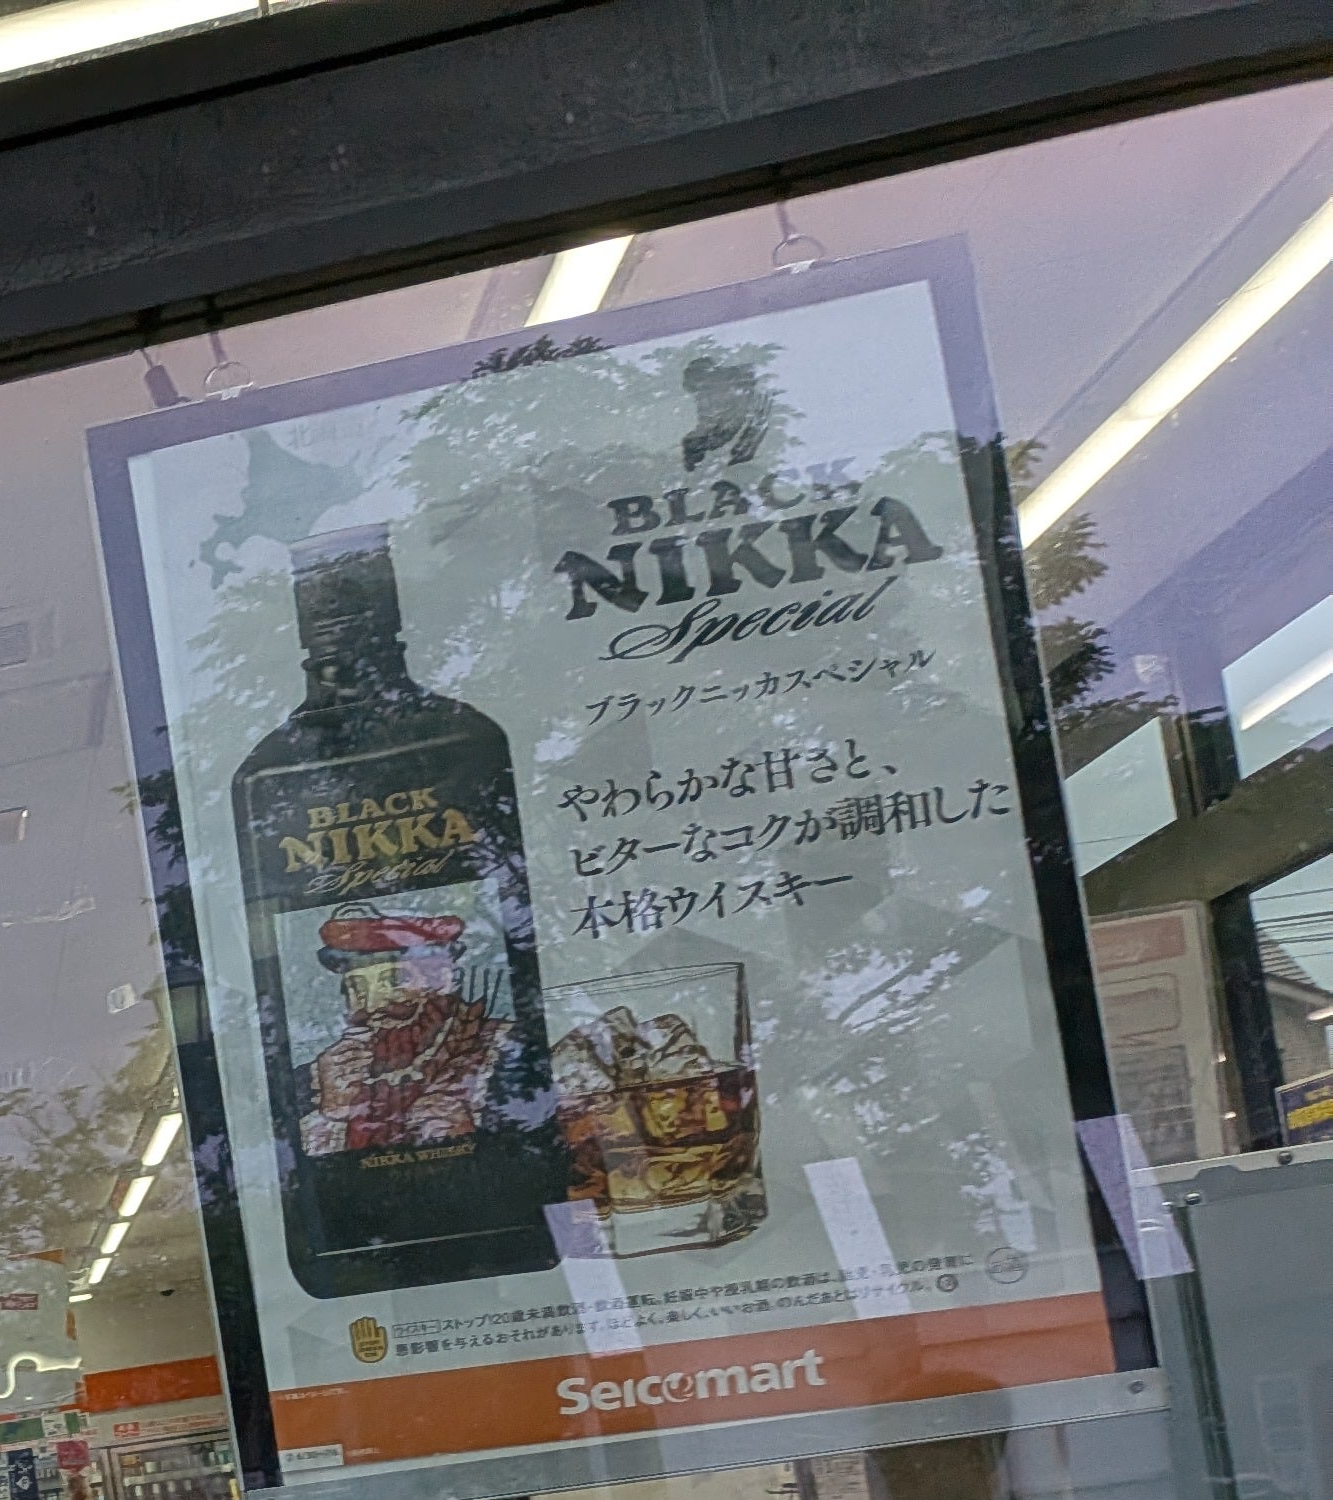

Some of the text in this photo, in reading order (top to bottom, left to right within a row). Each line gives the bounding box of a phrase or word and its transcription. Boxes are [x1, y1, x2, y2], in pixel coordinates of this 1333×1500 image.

[608, 456, 860, 536] BLACK
[553, 496, 943, 621] NIKKA
[599, 576, 898, 664] Special
[586, 649, 935, 726] ブラックニッカスペシャル
[308, 788, 438, 829] BLACK
[559, 738, 897, 822] やわらかな甘さと、
[279, 808, 478, 873] NIKKA
[574, 779, 1012, 879] ビターなコクが調和した
[572, 872, 853, 939] 本格ウイスキー
[556, 1349, 825, 1416] Seicomart
